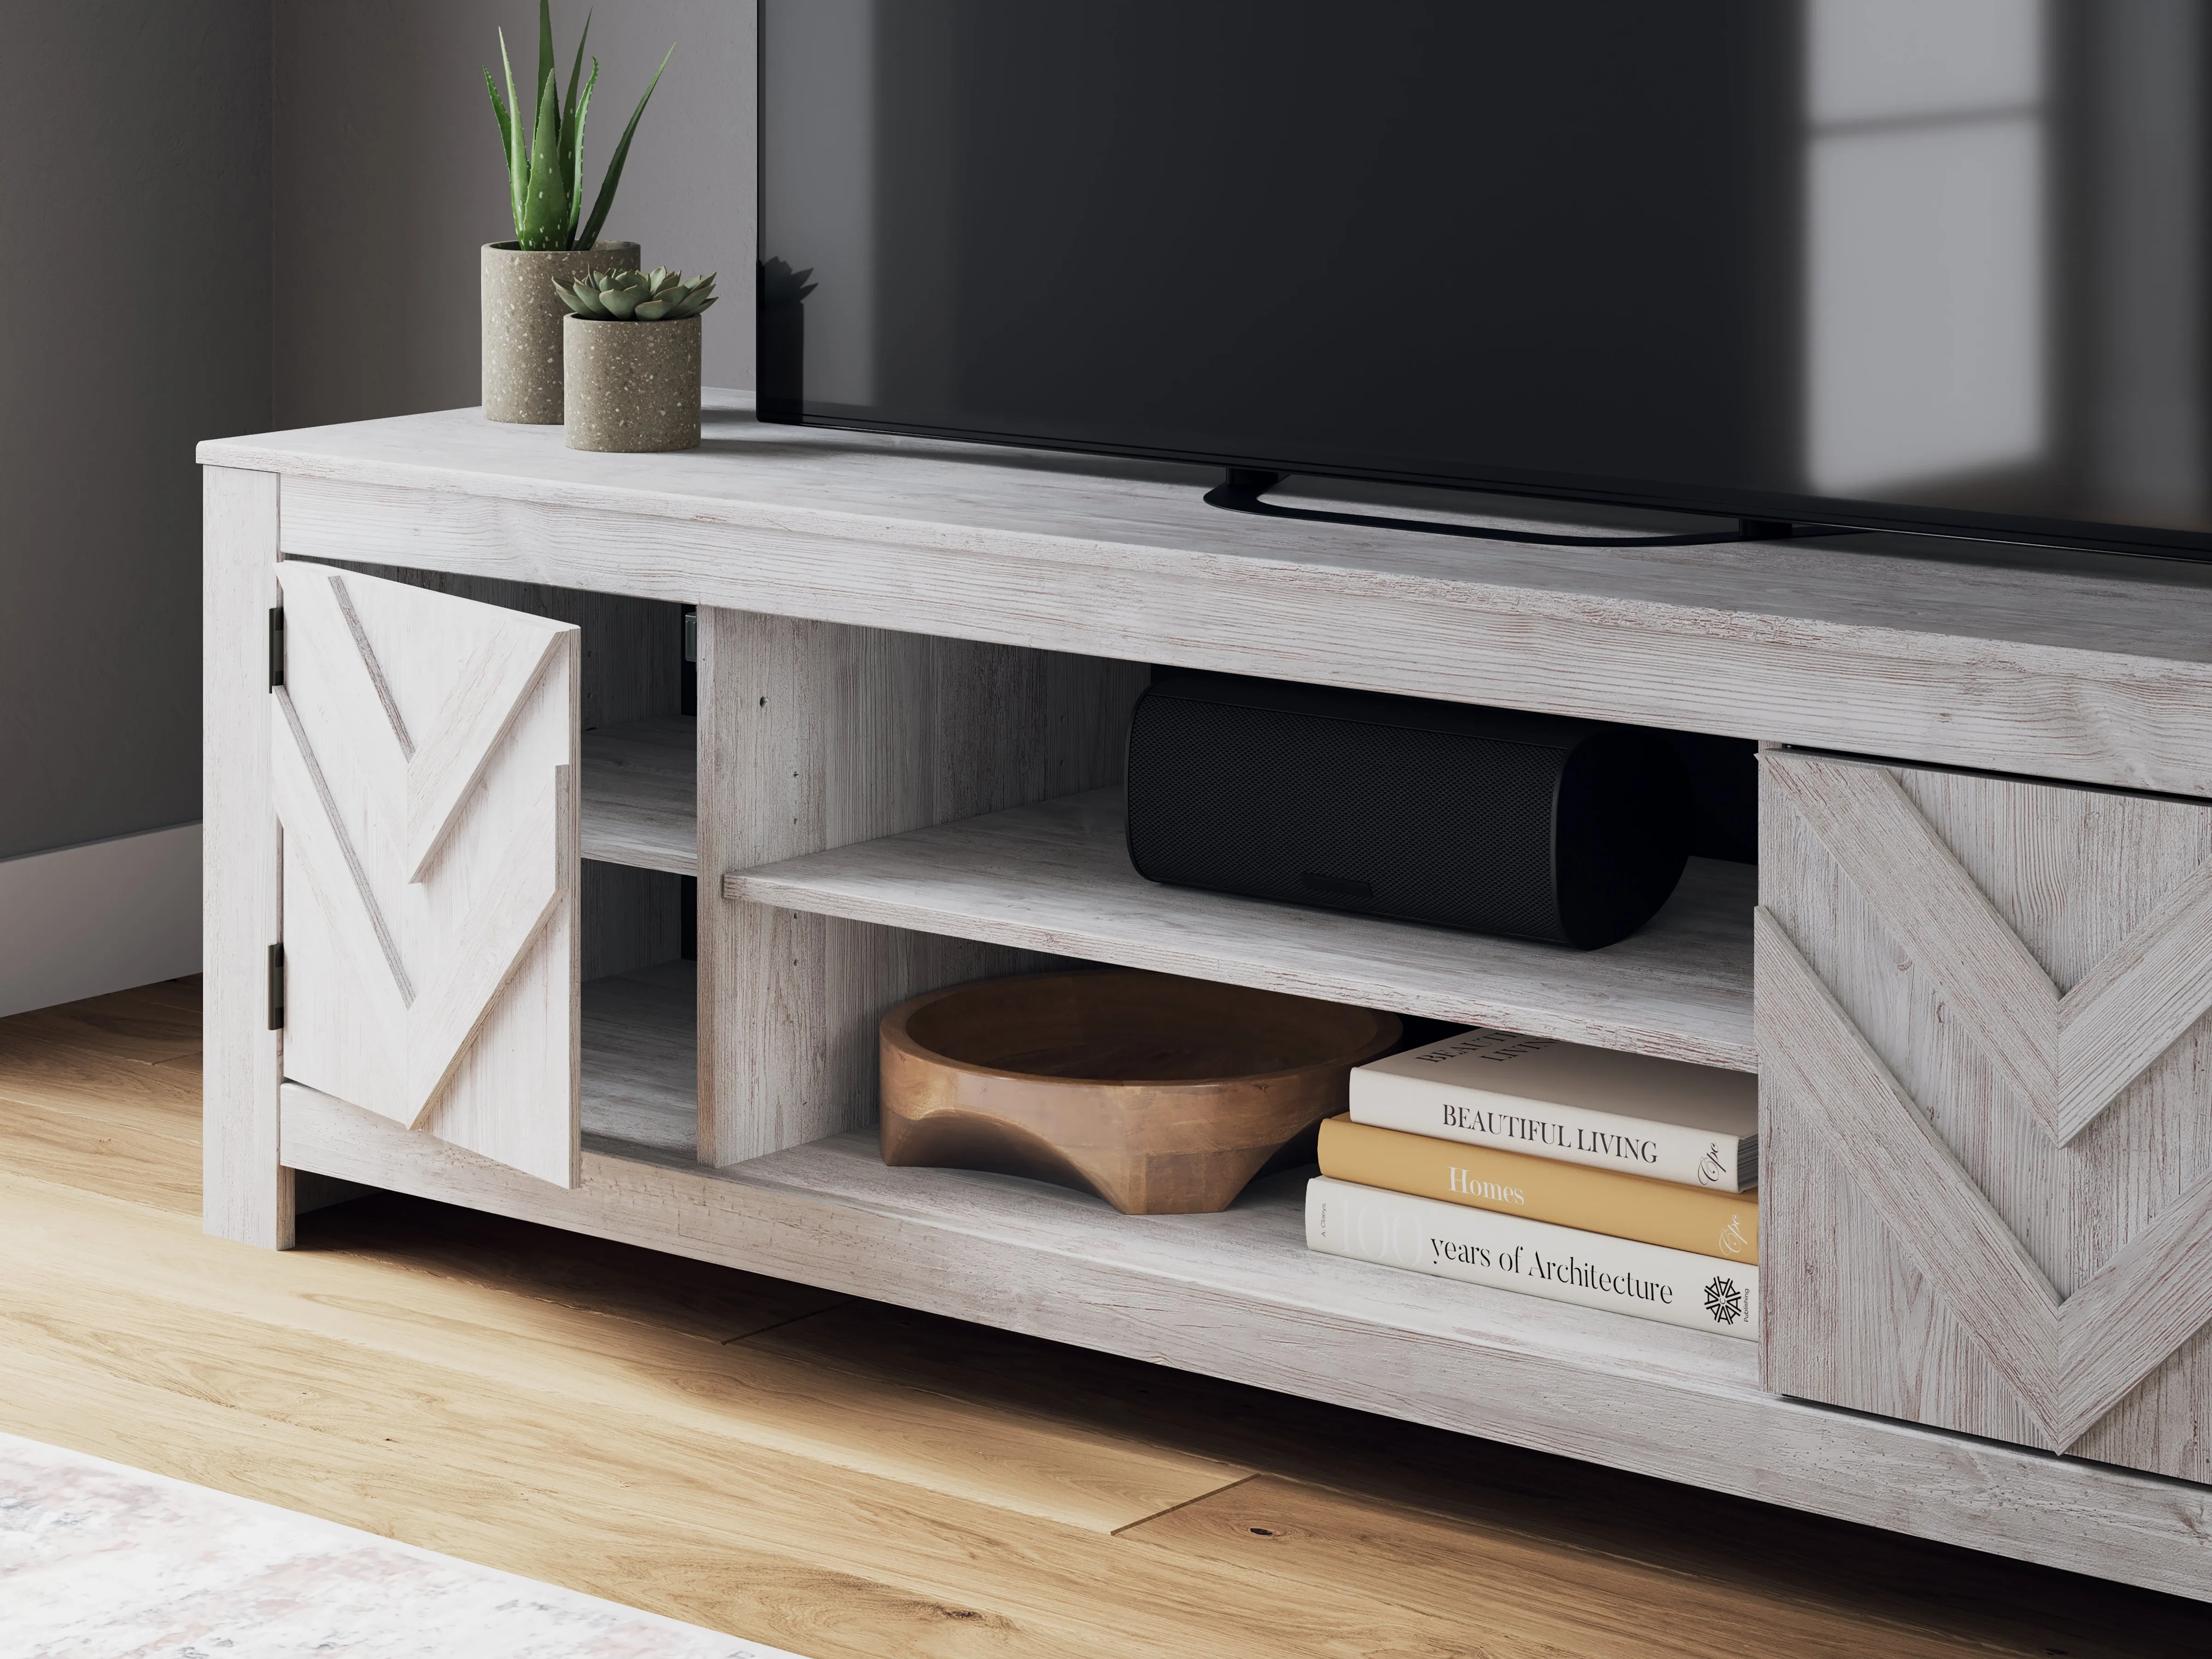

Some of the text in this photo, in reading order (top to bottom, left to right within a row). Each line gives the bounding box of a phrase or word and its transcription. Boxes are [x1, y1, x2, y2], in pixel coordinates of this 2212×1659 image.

[1414, 1031, 1524, 1062] BEAUTI
[1479, 1038, 1560, 1062] LIVIN
[1443, 1104, 1658, 1163] BEAUTIFUL LIVING
[1448, 1166, 1524, 1205] Homes
[1341, 1198, 1673, 1304] 100 years of Architecture
